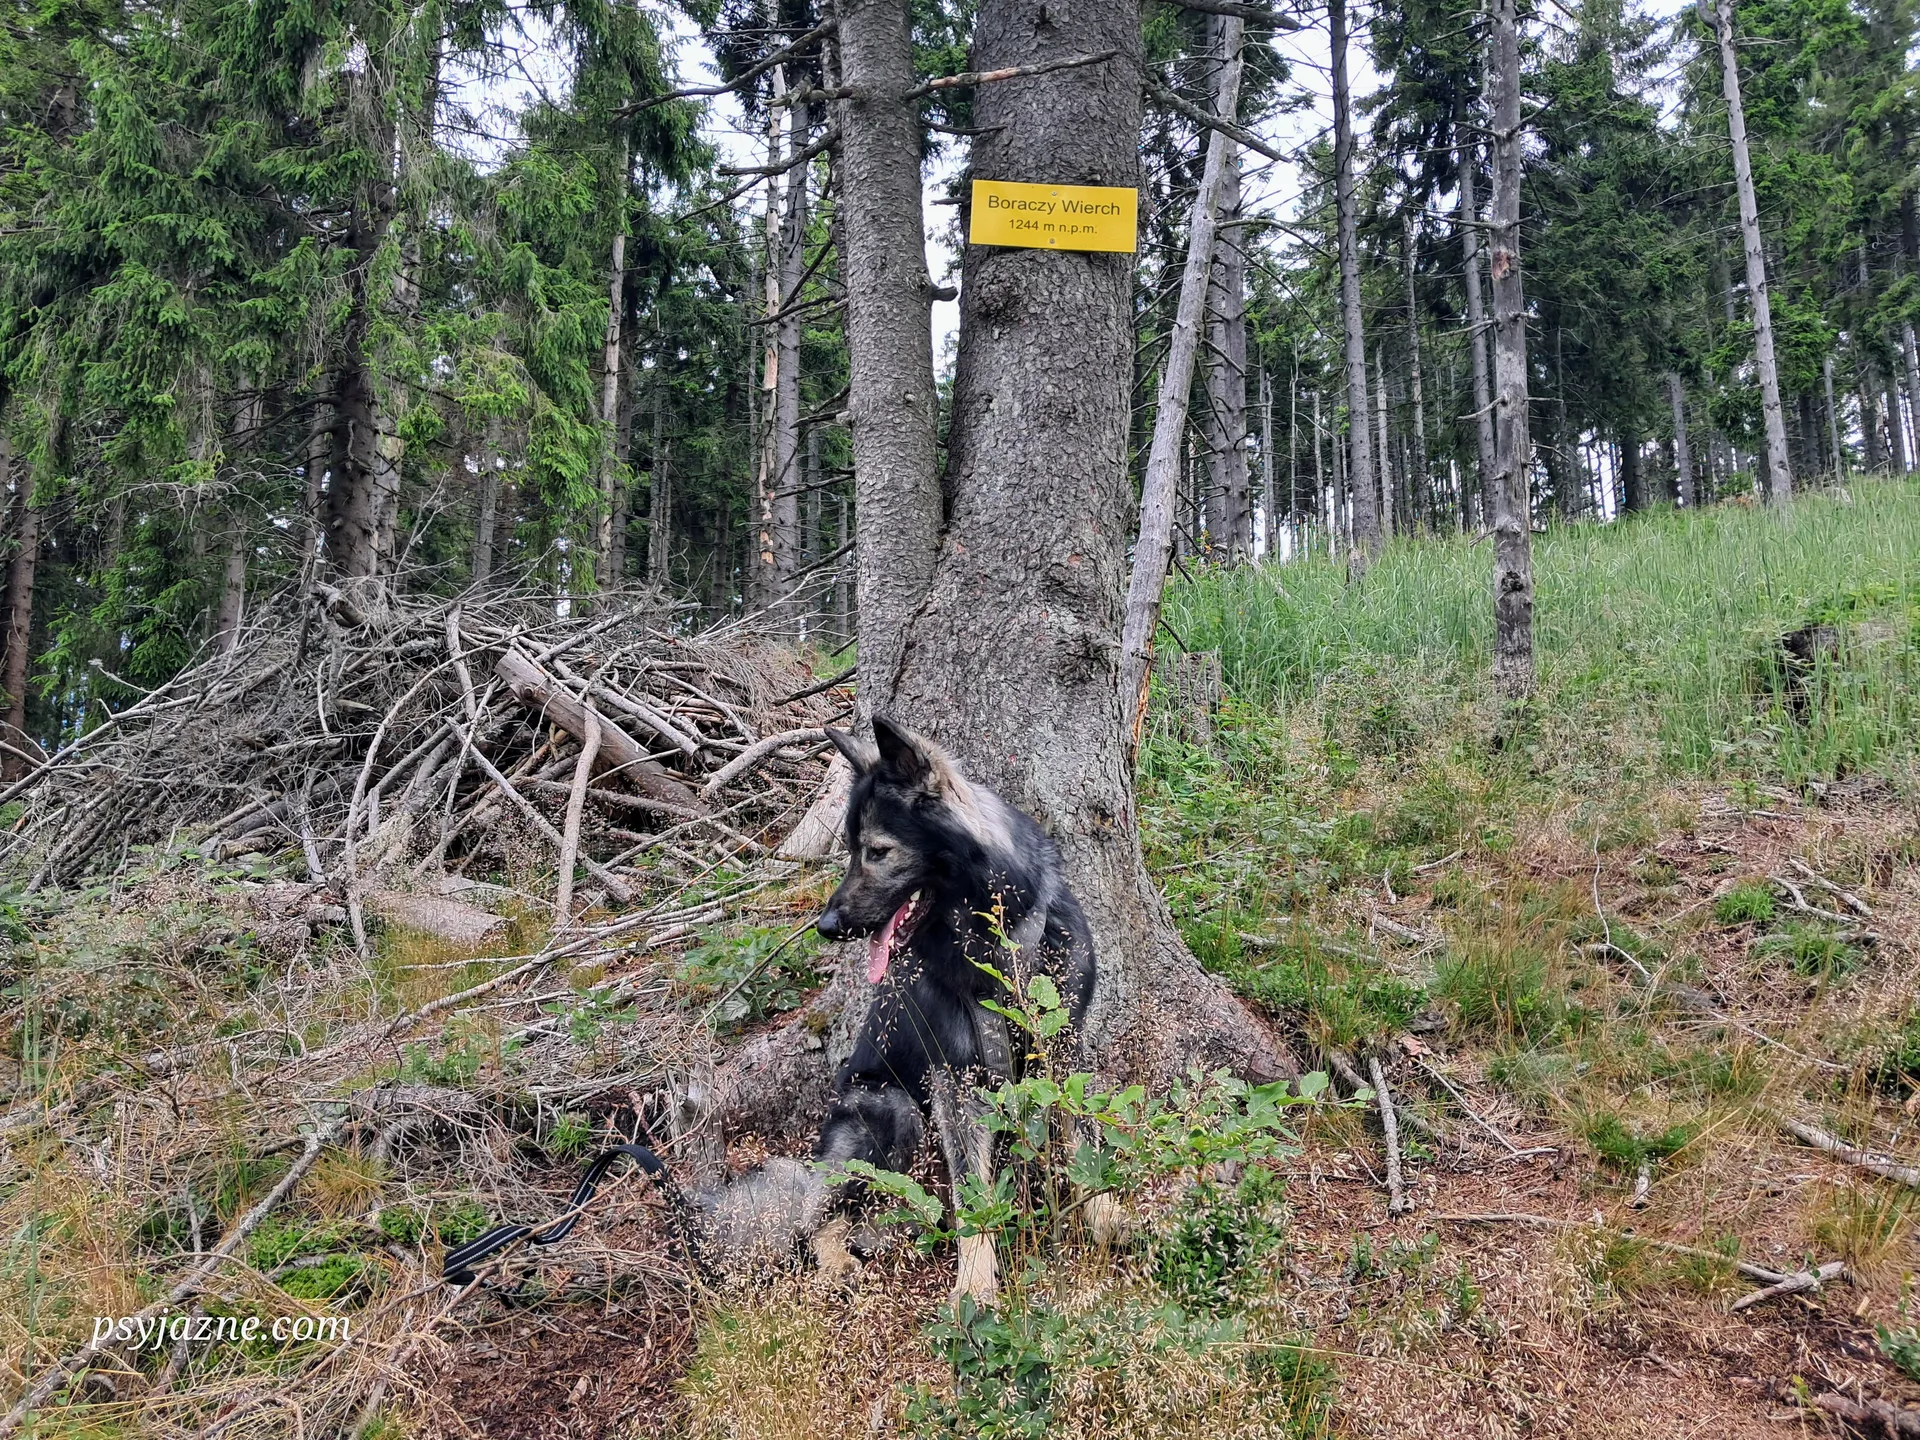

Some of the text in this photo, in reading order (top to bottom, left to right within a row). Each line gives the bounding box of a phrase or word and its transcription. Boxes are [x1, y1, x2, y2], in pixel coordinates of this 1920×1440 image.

[988, 195, 1120, 215] Boraczy Wierch
[1009, 219, 1098, 235] 1244 m n.p.m.
